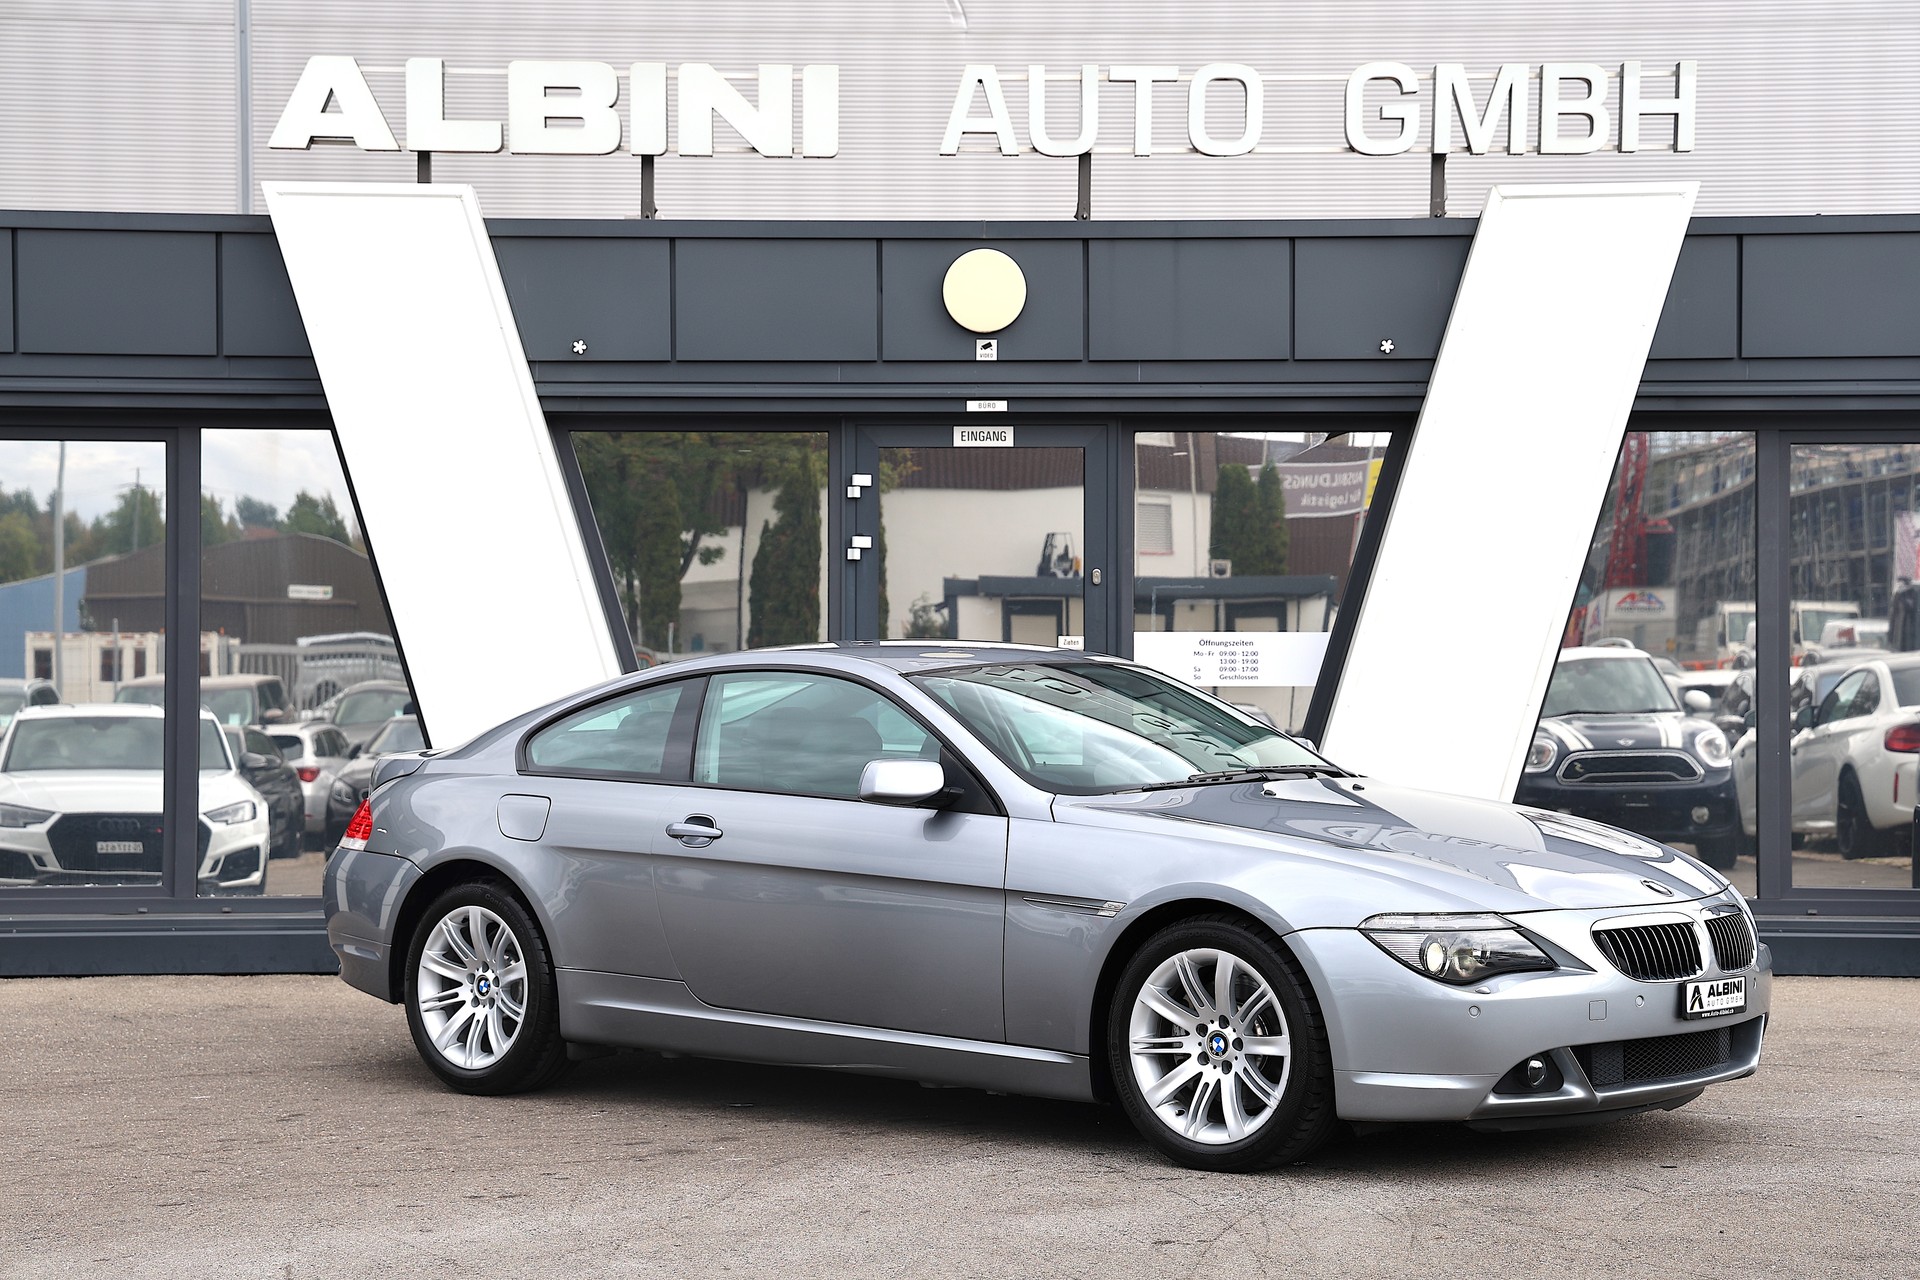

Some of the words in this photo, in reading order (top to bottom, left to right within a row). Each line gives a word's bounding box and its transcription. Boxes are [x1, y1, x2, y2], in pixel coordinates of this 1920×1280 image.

[268, 55, 840, 159] ALBINI
[939, 62, 1265, 158] AUTO
[1344, 60, 1699, 156] GMBH
[961, 430, 1007, 442] EINGANG
[1707, 980, 1743, 998] ALBINI
